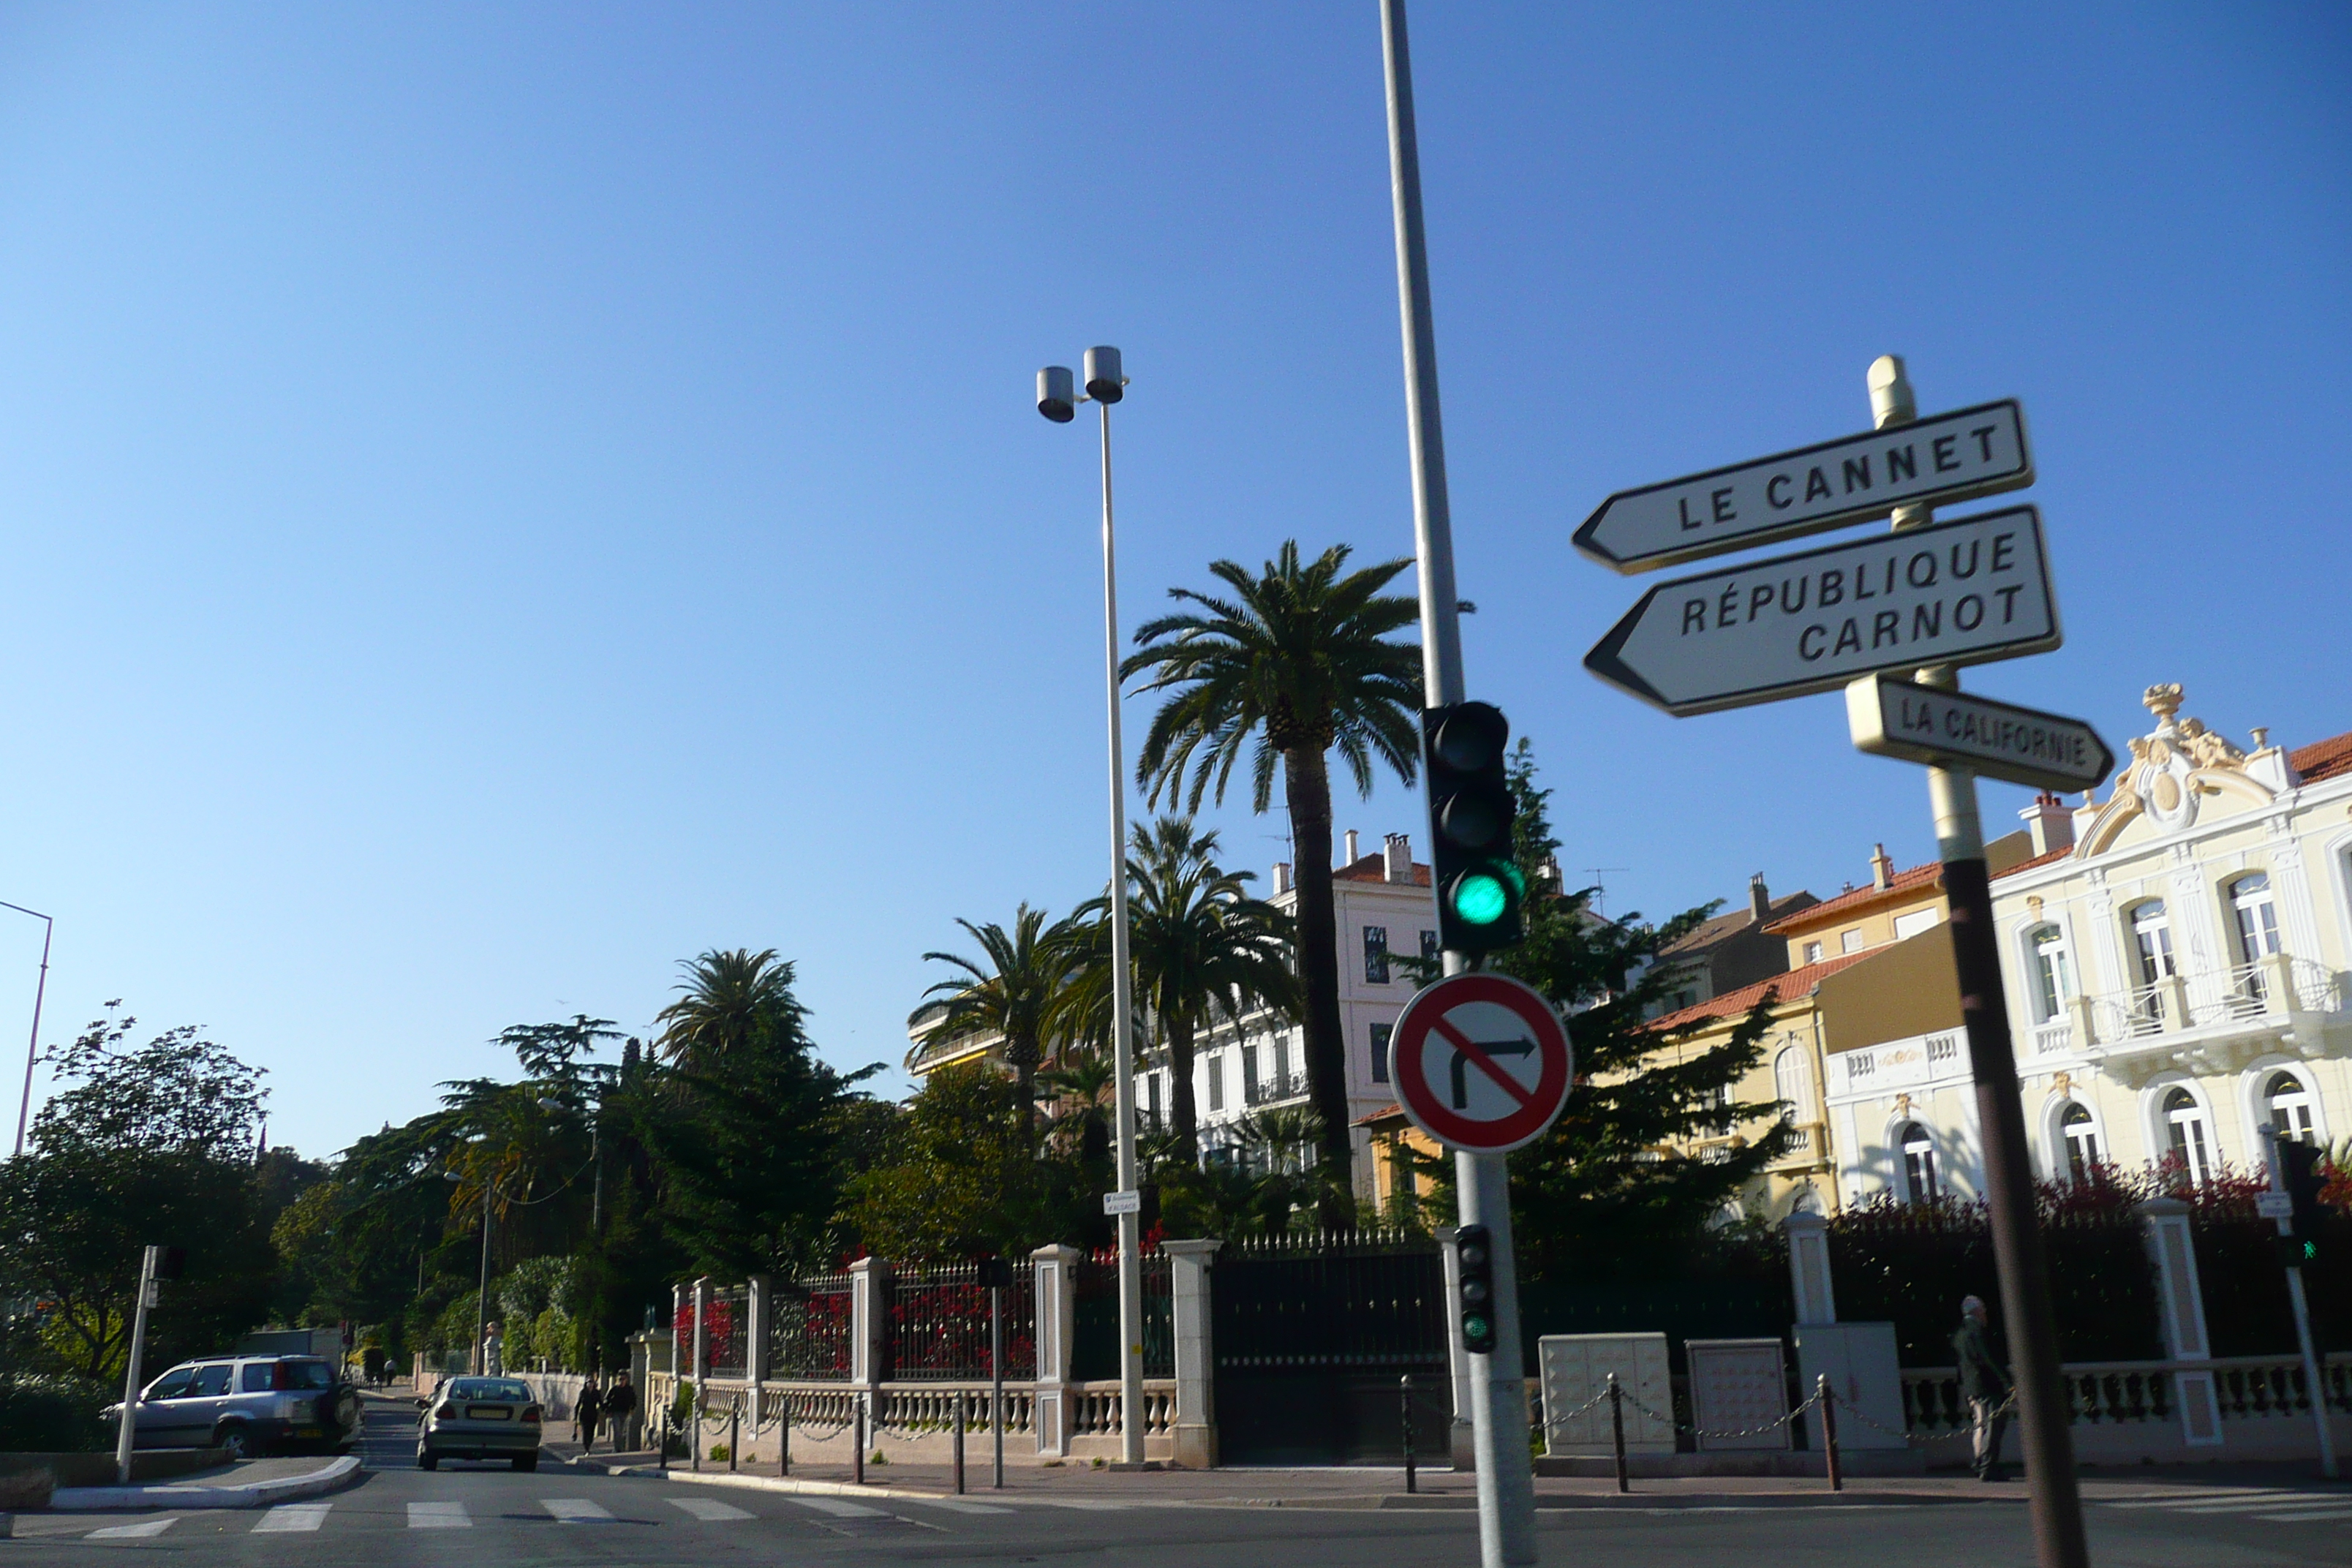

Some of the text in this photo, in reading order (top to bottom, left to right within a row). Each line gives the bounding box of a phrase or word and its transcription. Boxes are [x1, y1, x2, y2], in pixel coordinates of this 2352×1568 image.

[1679, 425, 1997, 531] LE CANNET
[1682, 532, 2016, 636] RÉPUBLIQUE
[1799, 586, 2024, 662] CARNOT
[1901, 697, 2087, 766] LA CALIFORNIE
